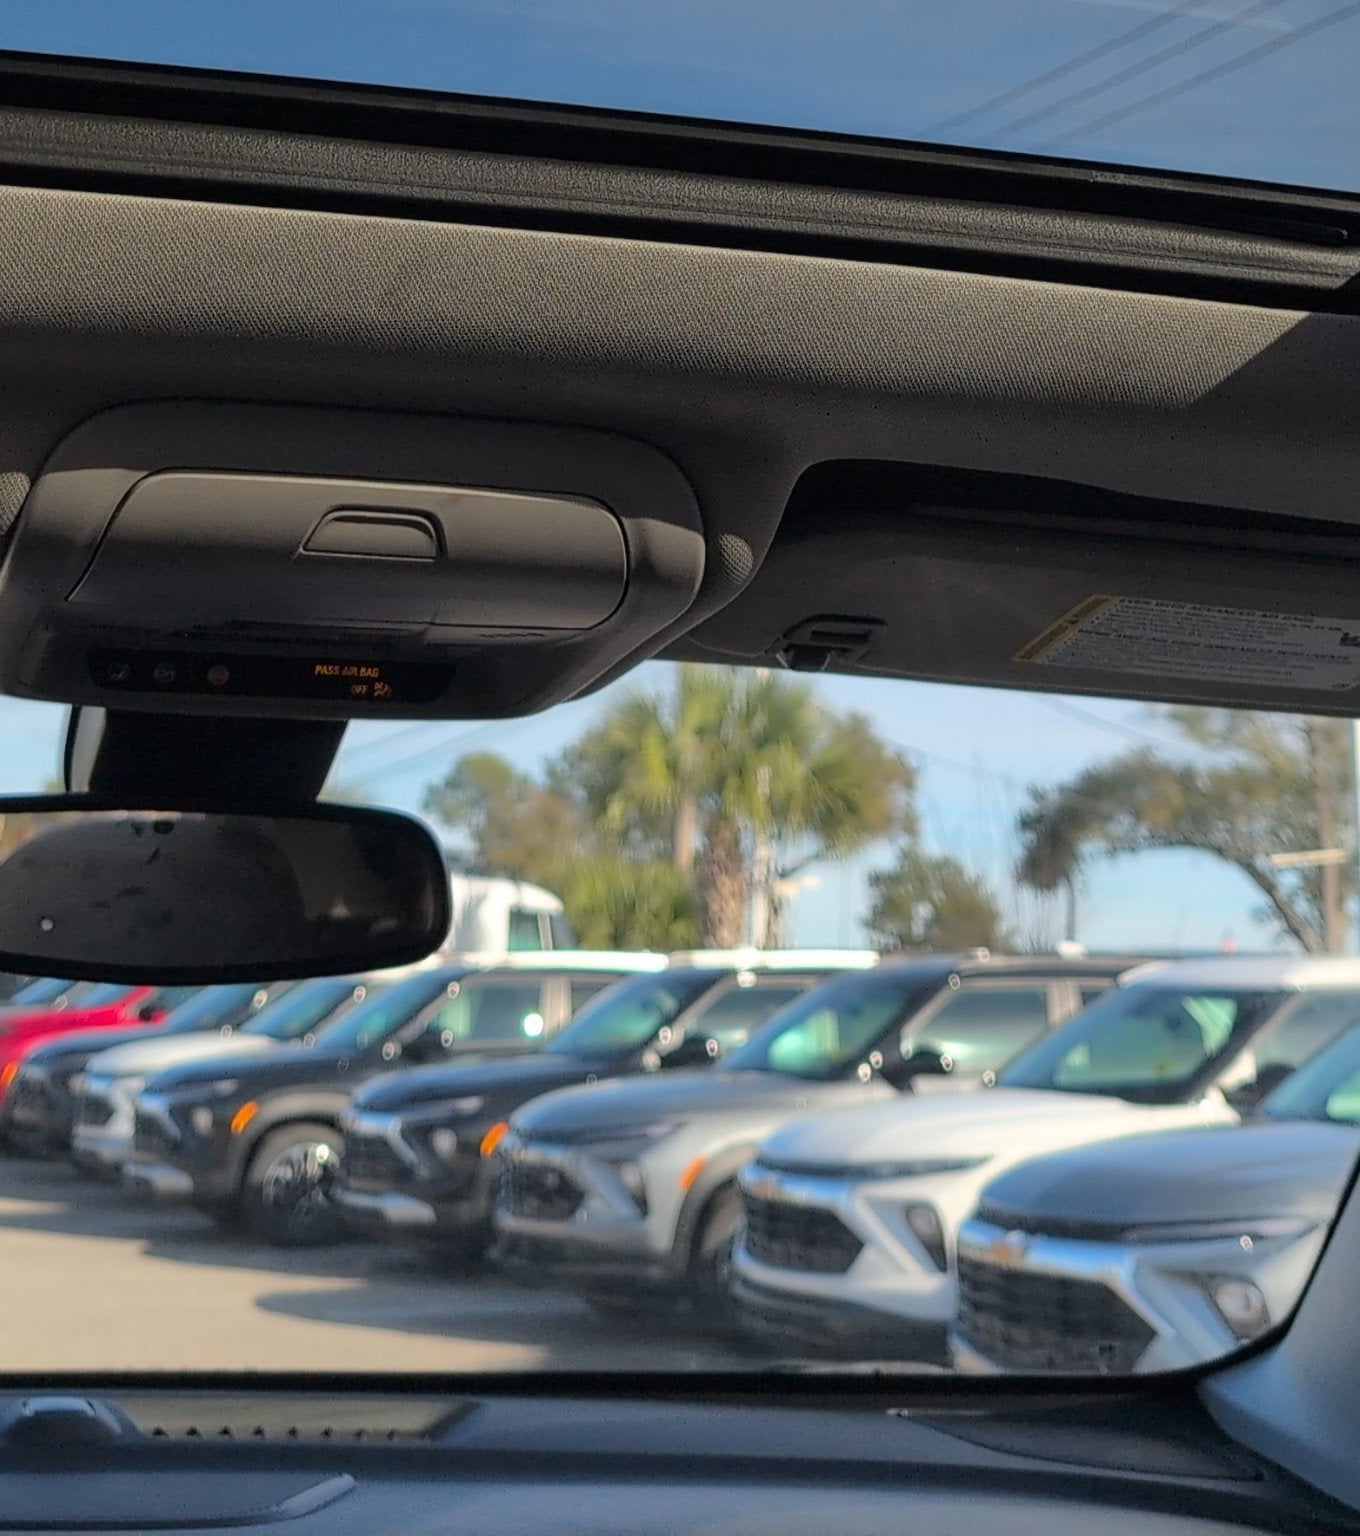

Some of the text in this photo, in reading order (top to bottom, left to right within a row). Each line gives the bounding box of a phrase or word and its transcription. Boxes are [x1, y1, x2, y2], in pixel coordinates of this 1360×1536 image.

[314, 664, 379, 678] PASS AIR BAG
